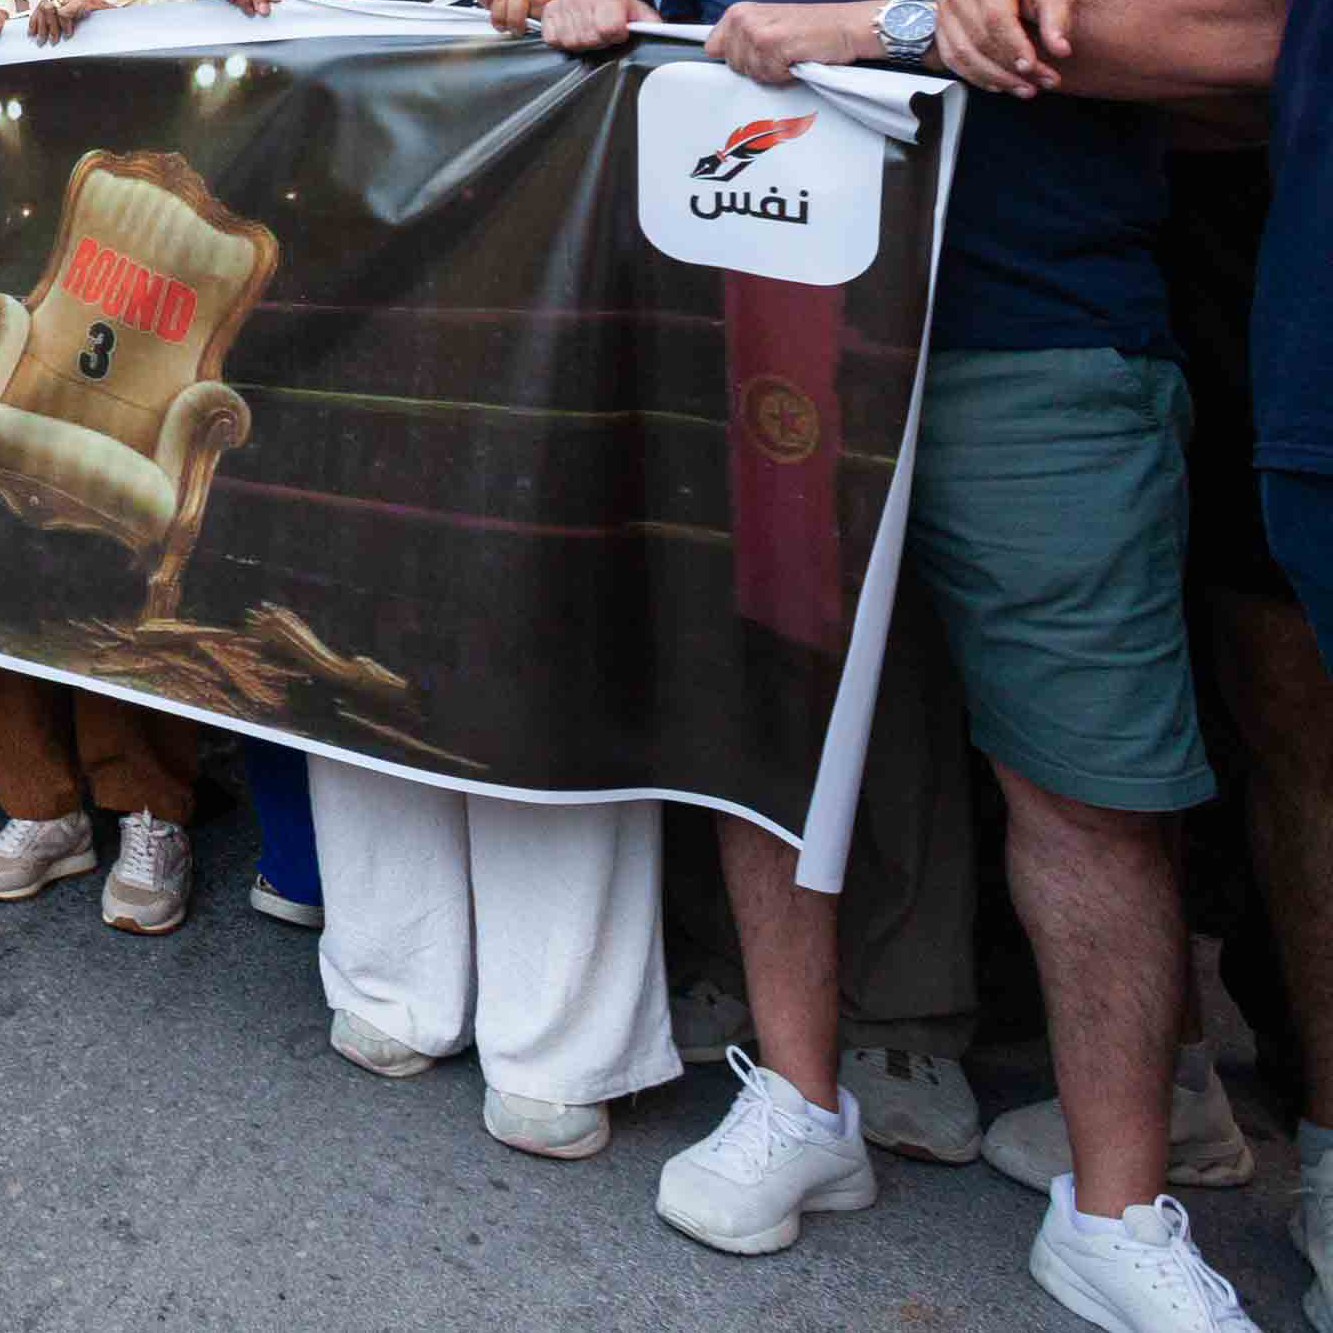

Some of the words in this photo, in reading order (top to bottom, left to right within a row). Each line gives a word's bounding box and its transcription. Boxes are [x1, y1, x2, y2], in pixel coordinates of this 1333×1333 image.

[689, 186, 809, 225] نفس
[58, 235, 199, 346] ROUND
[77, 319, 117, 381] 3
